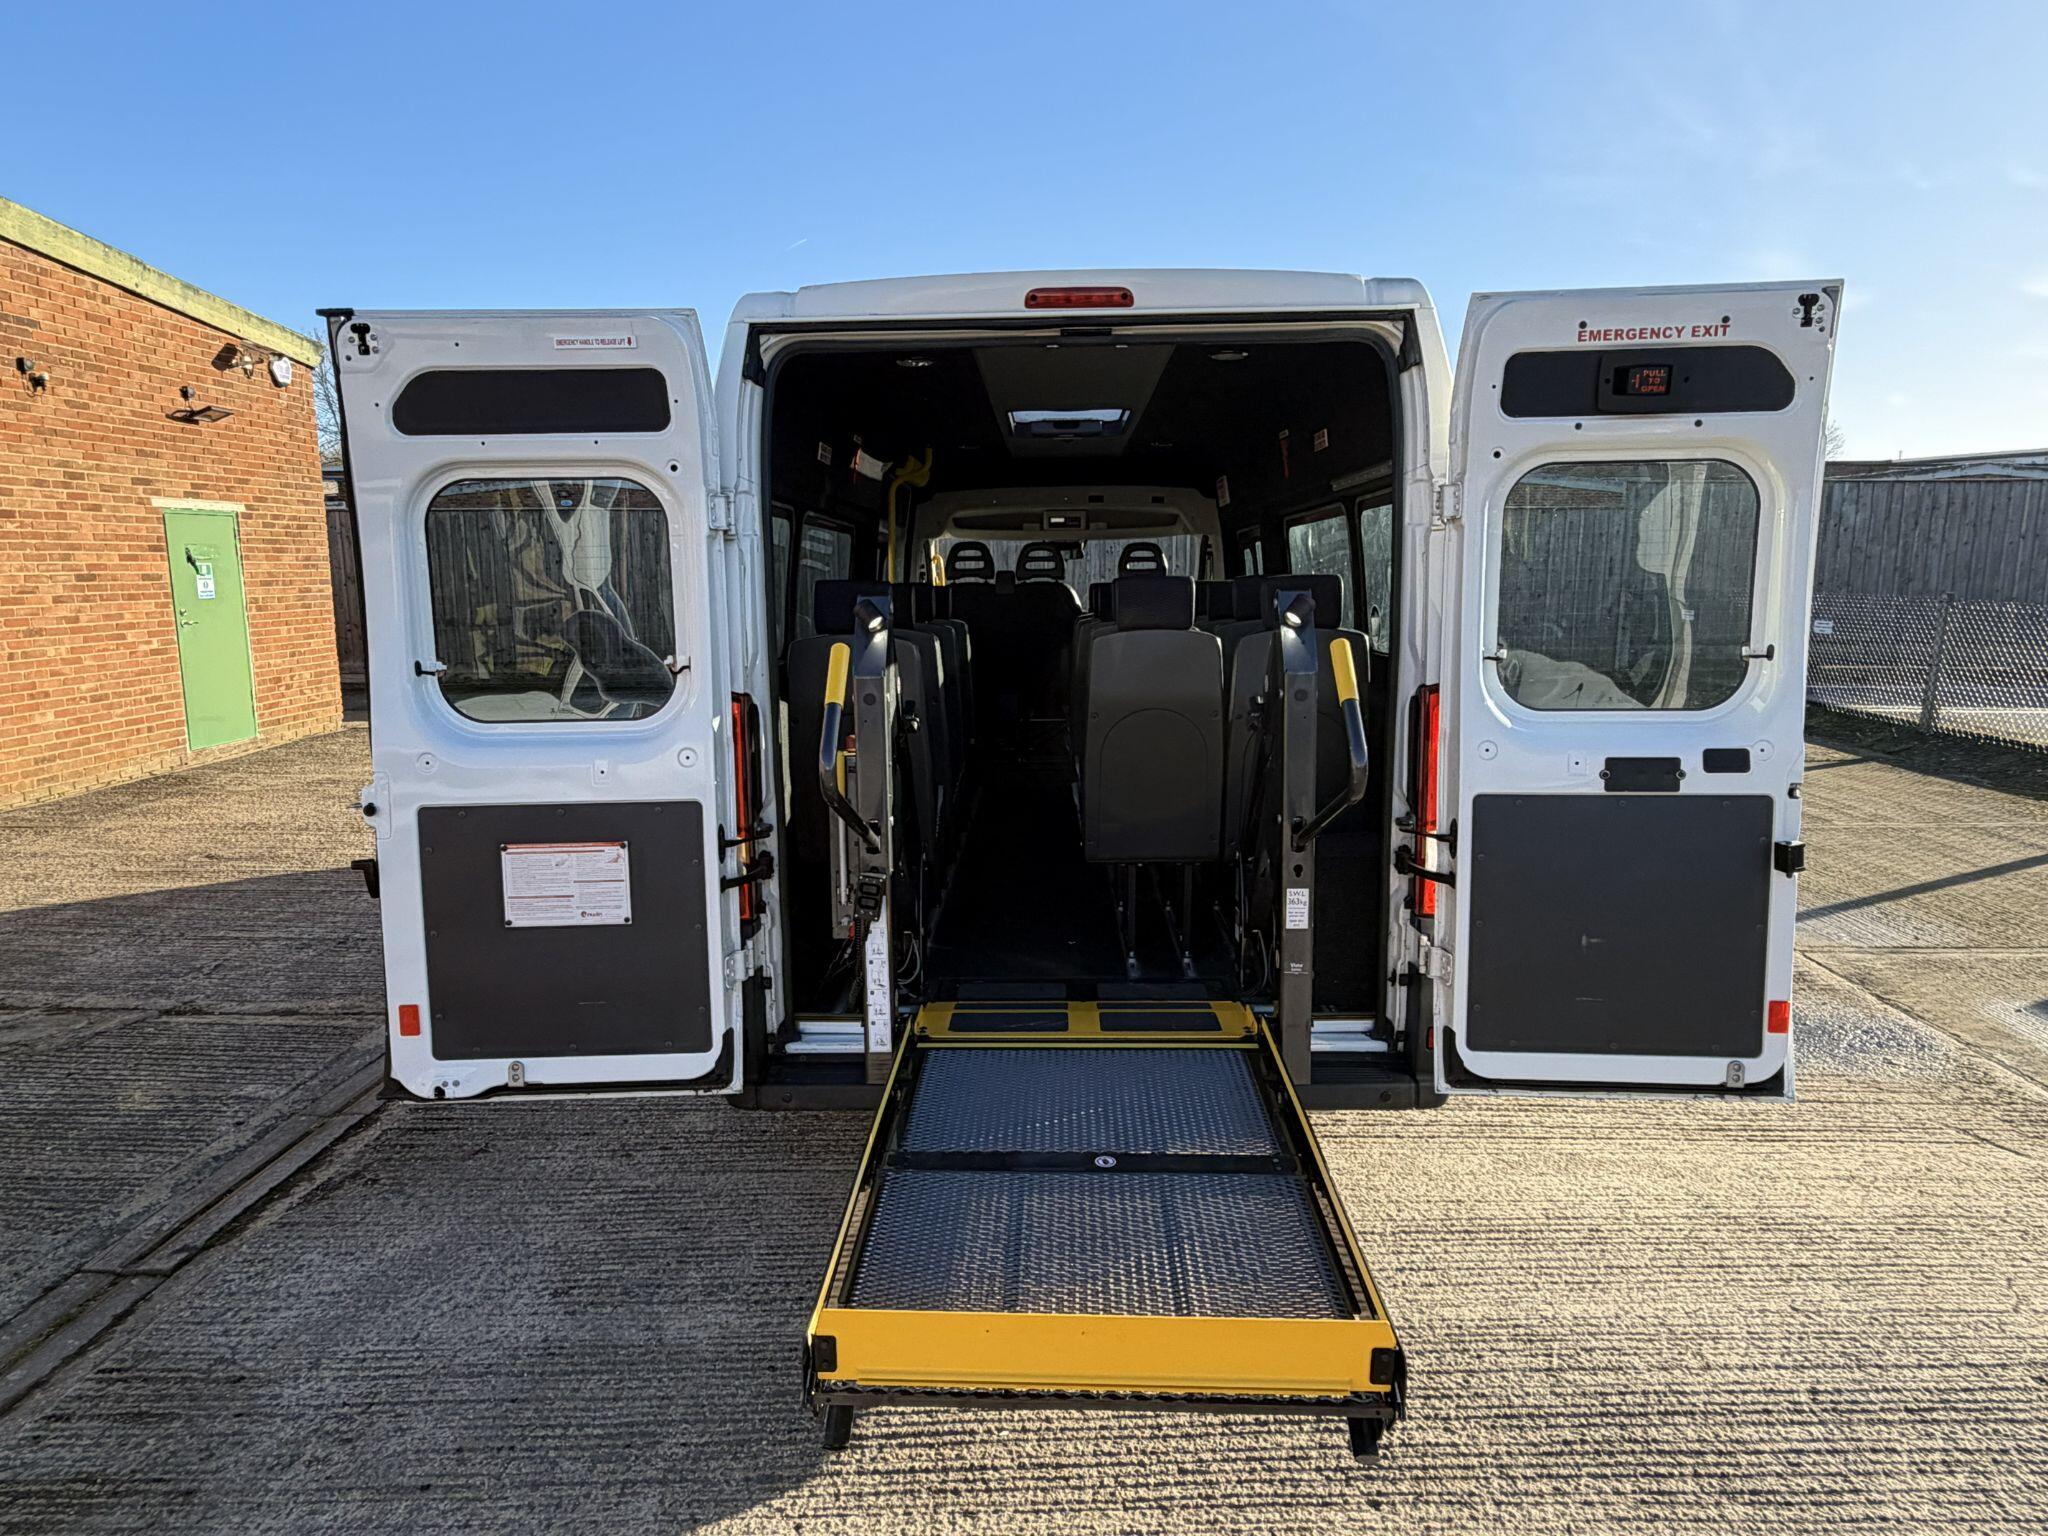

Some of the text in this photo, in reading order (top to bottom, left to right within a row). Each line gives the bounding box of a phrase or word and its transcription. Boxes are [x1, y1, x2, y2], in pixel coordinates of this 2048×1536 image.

[1577, 324, 1731, 342] EMERGENCY EXIT
[1643, 369, 1666, 377] PULL
